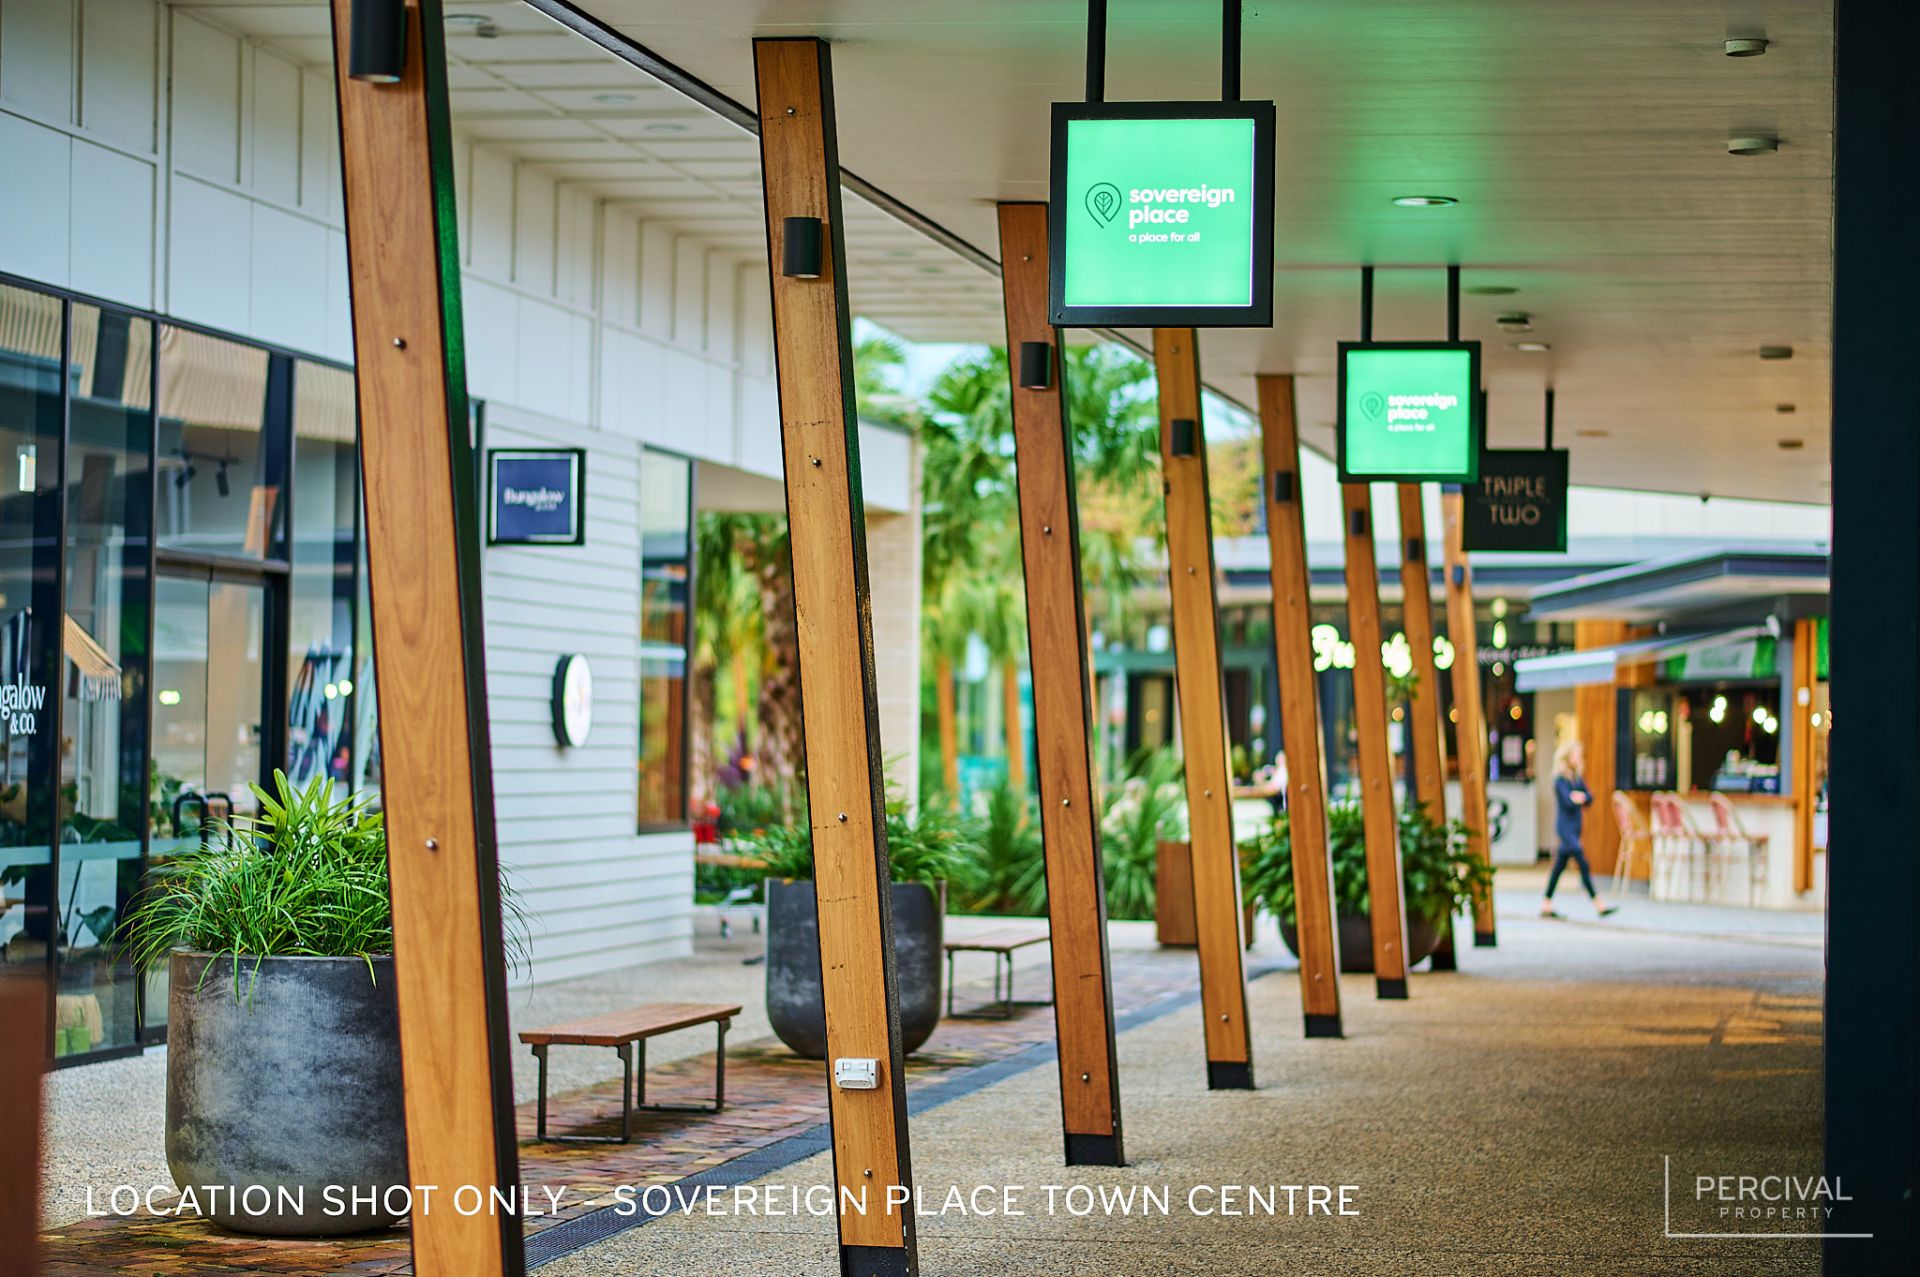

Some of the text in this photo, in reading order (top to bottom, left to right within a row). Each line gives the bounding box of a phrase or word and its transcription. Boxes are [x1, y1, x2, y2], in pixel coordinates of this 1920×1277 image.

[1129, 184, 1235, 208] sovereign
[1129, 205, 1189, 230] place
[1128, 232, 1201, 244] a place for all
[1387, 392, 1457, 410] sovereign
[1387, 405, 1428, 423] place
[1483, 475, 1545, 497] TRIPLE
[1490, 504, 1540, 526] TWO
[0, 672, 46, 720] galow
